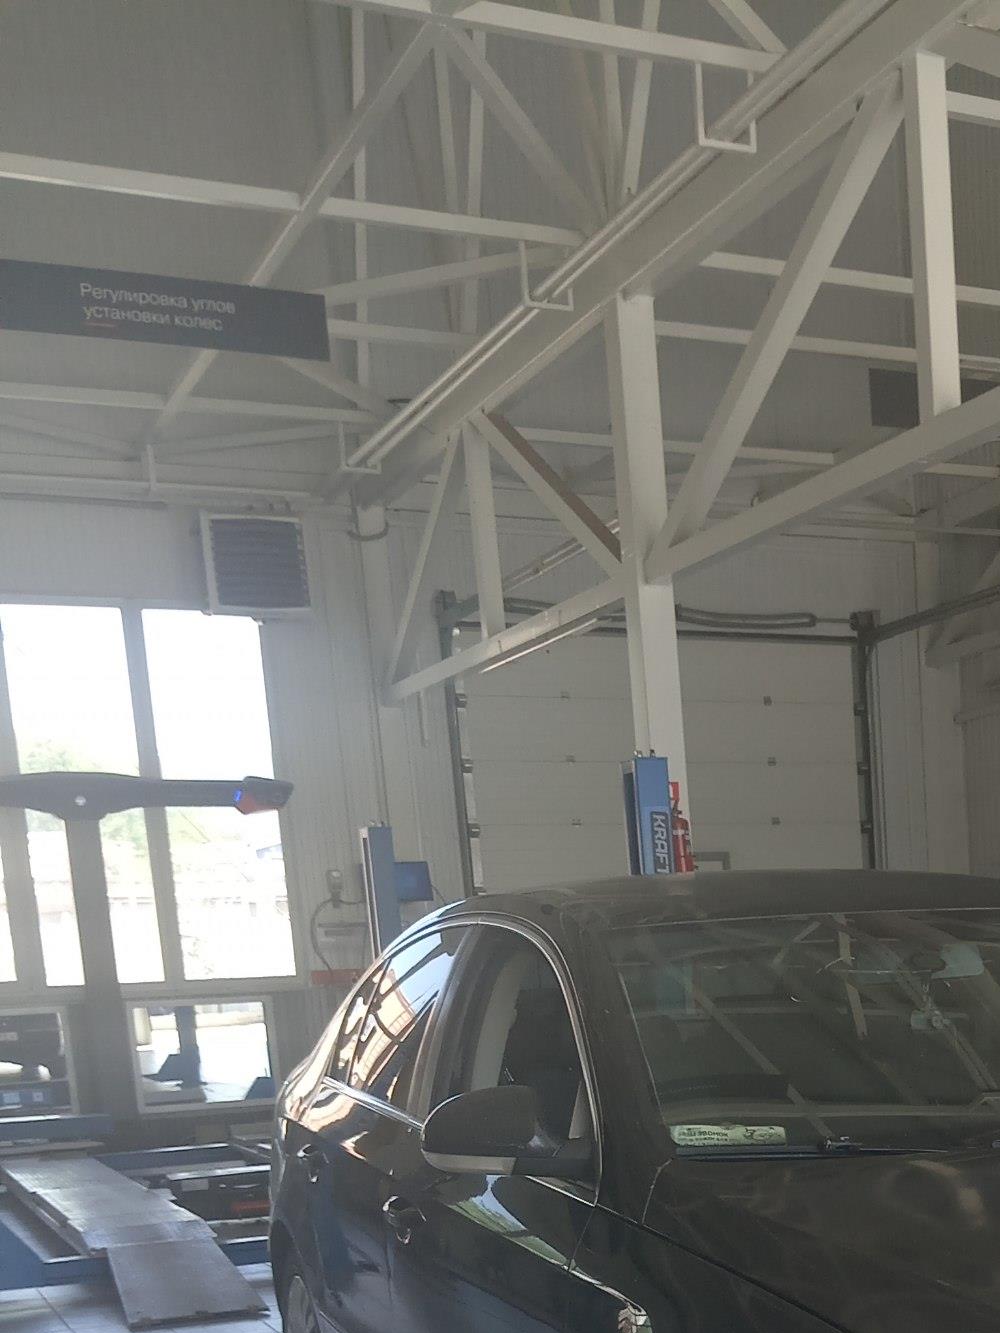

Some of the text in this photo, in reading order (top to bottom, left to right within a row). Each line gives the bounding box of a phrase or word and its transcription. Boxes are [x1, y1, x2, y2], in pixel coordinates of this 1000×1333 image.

[80, 282, 236, 315] Регулировка углов
[83, 305, 224, 332] установки колес
